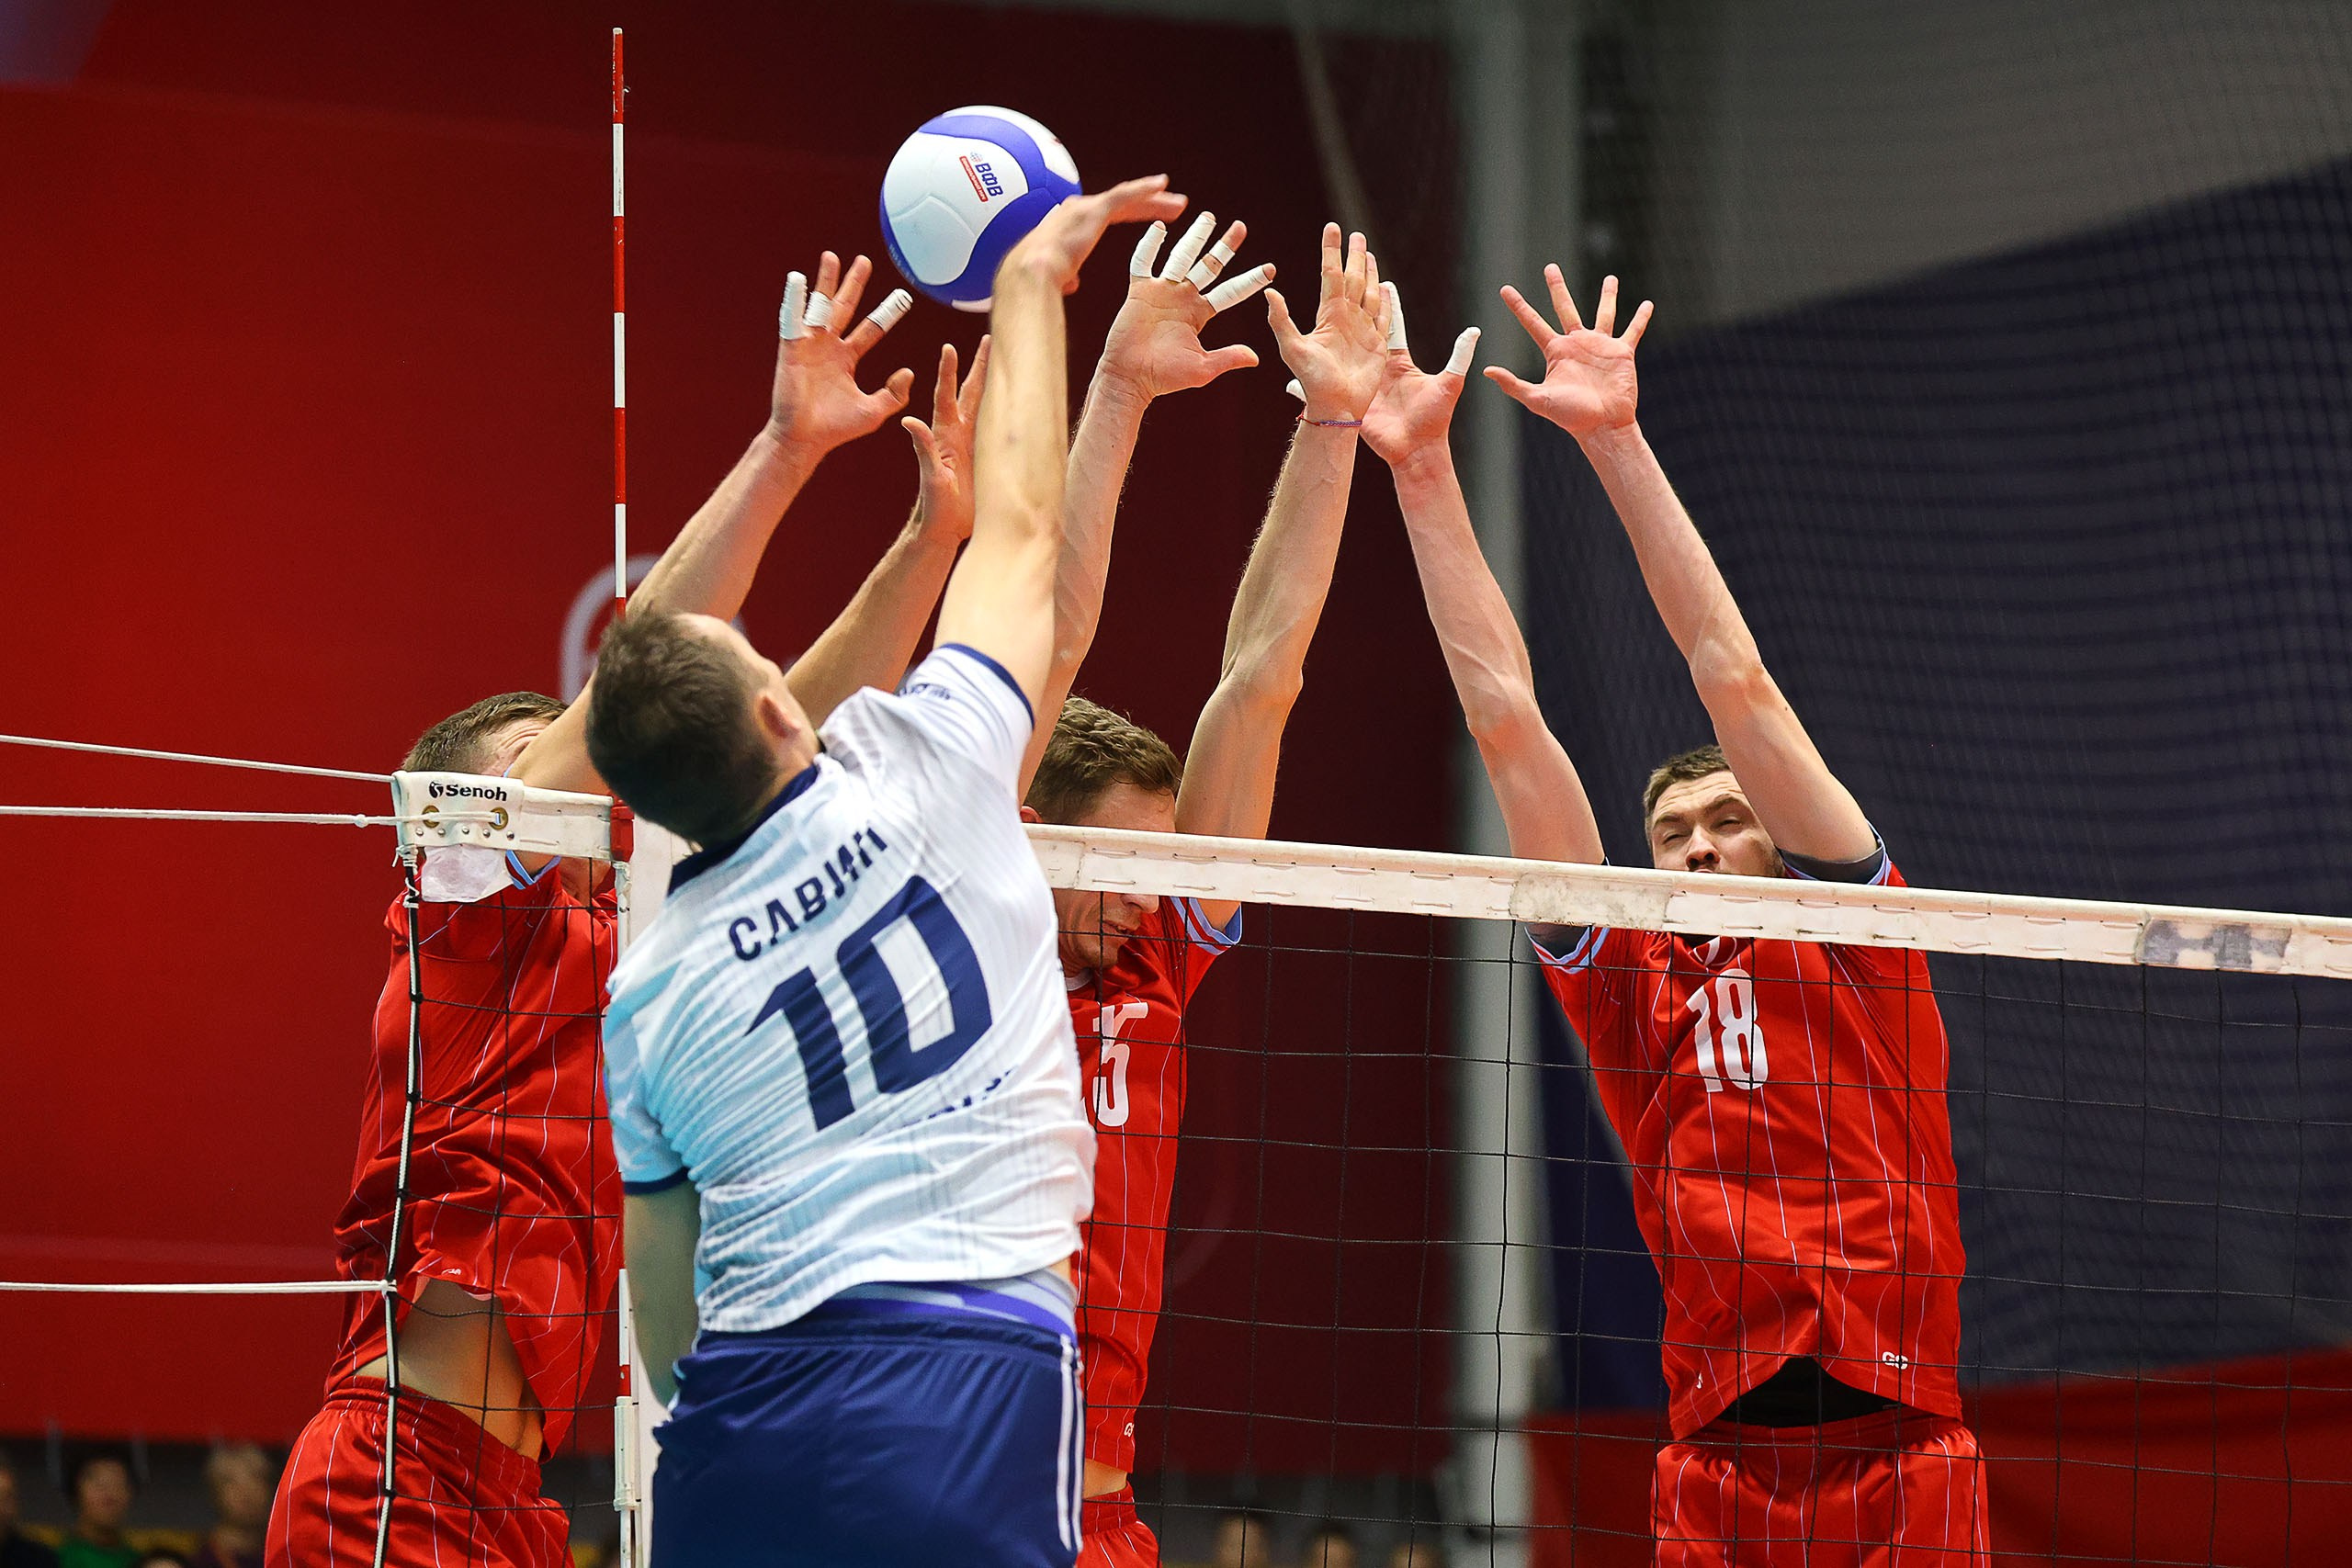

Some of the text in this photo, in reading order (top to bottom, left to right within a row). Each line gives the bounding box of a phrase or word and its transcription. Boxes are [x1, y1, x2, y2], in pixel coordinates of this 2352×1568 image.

[975, 163, 1003, 197] ВФВ
[446, 784, 507, 802] Senoh
[743, 874, 993, 1132] 10
[1685, 967, 1770, 1093] 18
